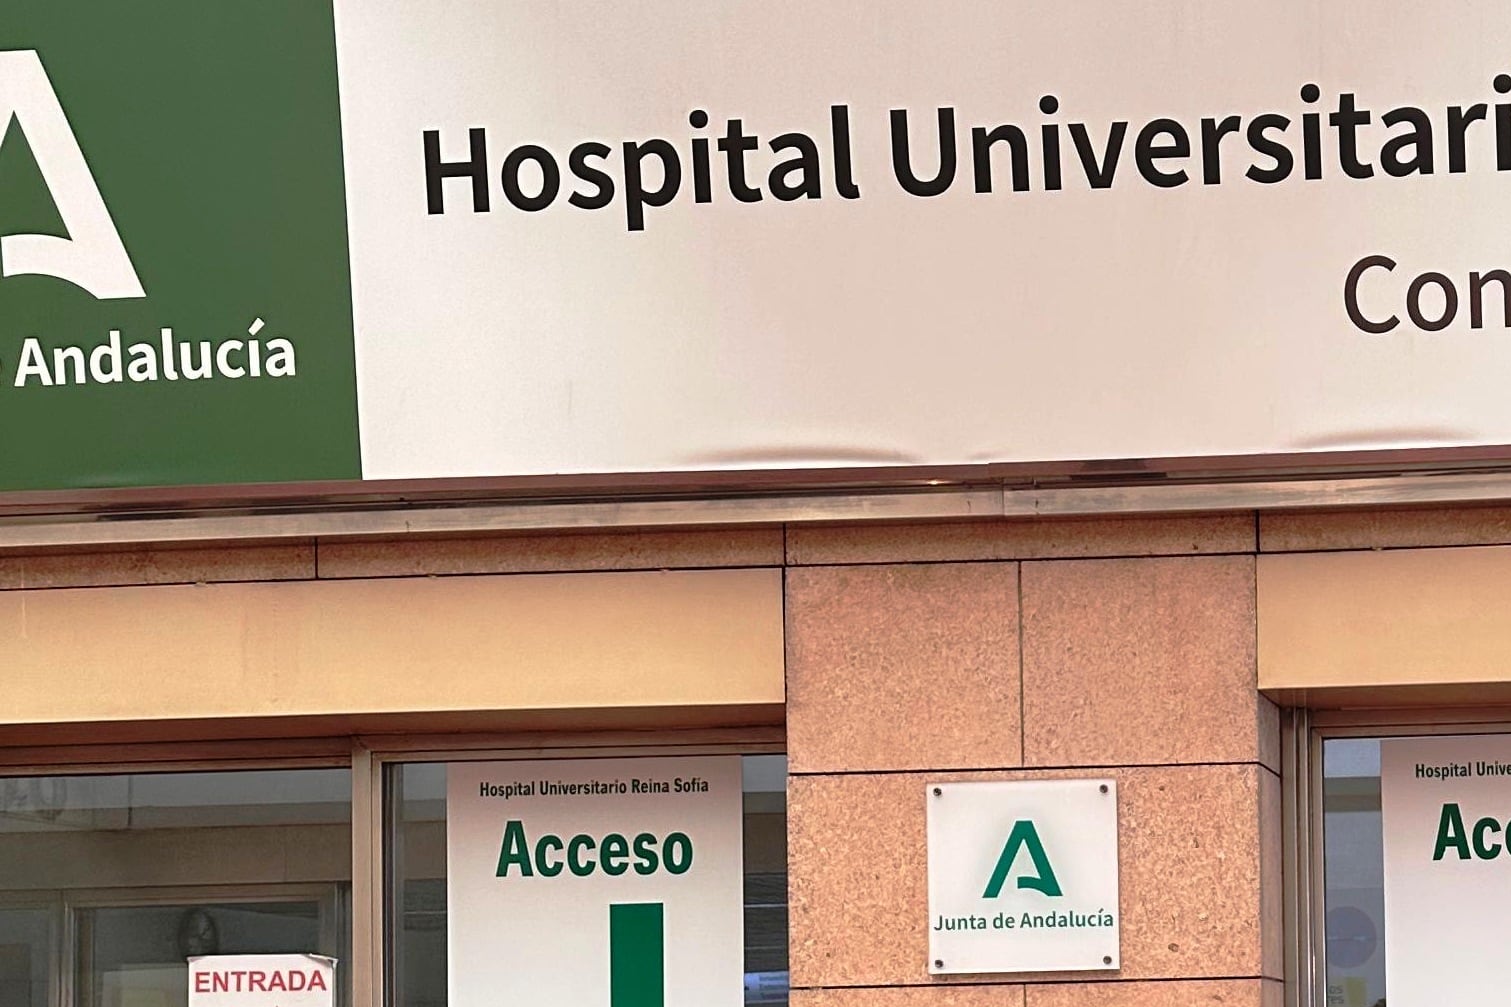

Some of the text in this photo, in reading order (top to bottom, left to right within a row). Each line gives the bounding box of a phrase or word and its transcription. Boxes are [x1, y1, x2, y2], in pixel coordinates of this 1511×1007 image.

[422, 104, 861, 231] Hospital
[14, 317, 296, 387] Andalucía
[1415, 761, 1472, 781] Hospital
[479, 776, 709, 800] Hospital Universitario Reina Sofía
[495, 819, 694, 878] Acceso
[934, 908, 1114, 931] Junta de Andalucía
[194, 970, 327, 993] ENTRADA
